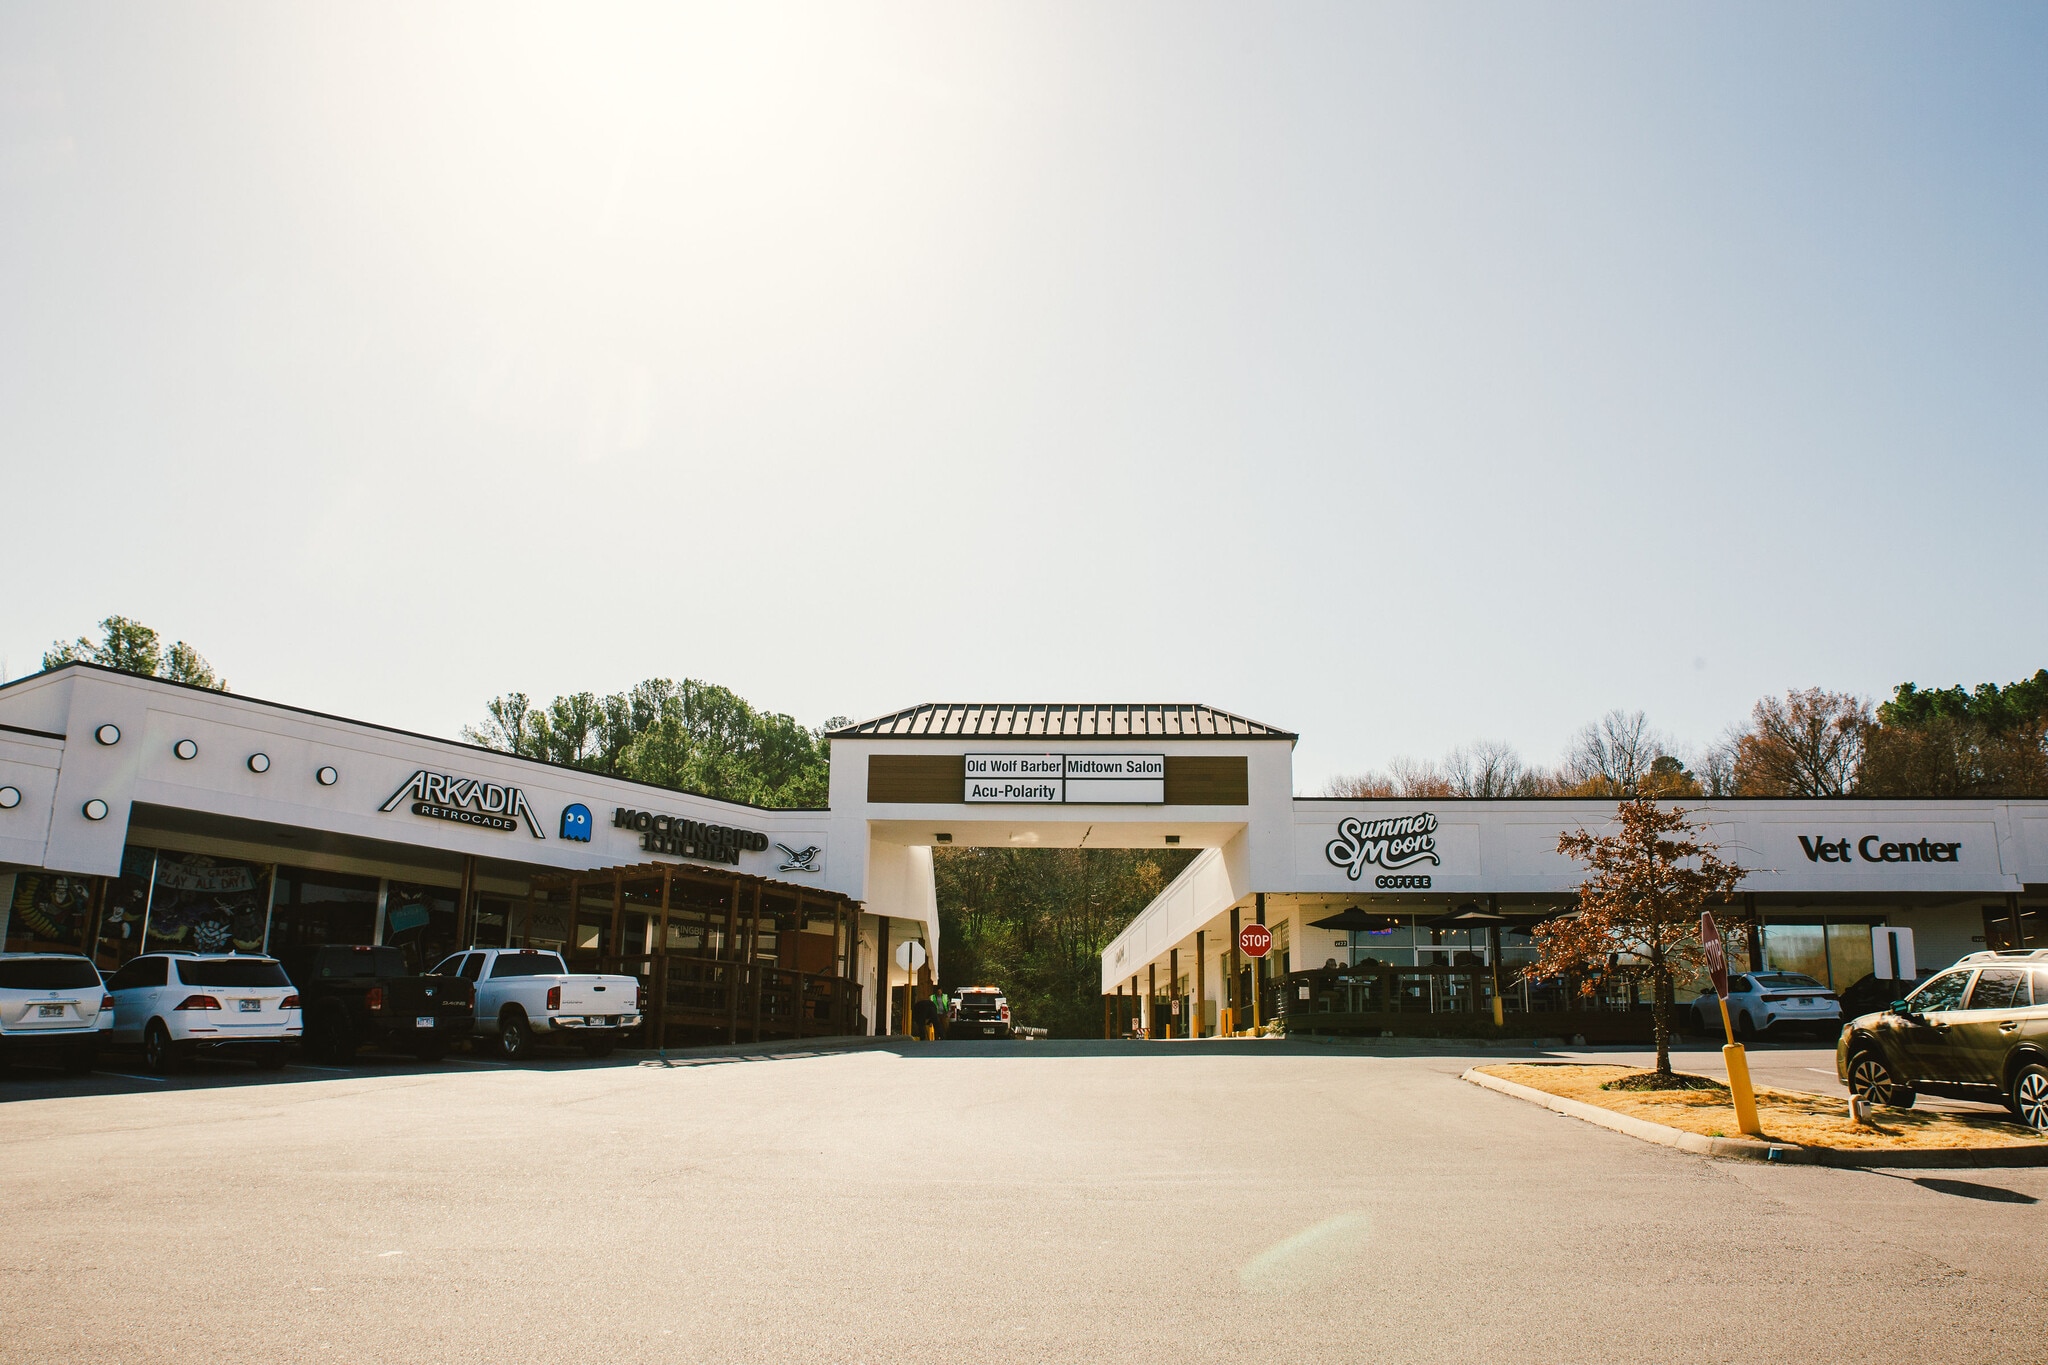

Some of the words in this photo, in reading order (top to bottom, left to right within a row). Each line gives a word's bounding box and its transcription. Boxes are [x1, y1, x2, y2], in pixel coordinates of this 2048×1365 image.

[967, 760, 987, 772] Old
[990, 760, 1017, 772] Wolf
[1021, 760, 1061, 773] Barber
[1067, 760, 1122, 773] Midtown
[1126, 760, 1162, 773] Salon
[378, 770, 546, 840] ARKADIA
[972, 784, 1056, 800] Acu-Polarity
[421, 805, 511, 829] RETROCADE
[614, 807, 769, 852] MOCKINGBIRD
[643, 832, 741, 866] KITCHEN
[1328, 812, 1438, 865] Summer
[1797, 835, 1852, 863] Vet
[1857, 835, 1962, 863] Center
[1351, 833, 1440, 879] Moon
[1377, 877, 1430, 887] COFFEE
[1241, 934, 1270, 947] STOP
[1705, 938, 1722, 973] STOP
